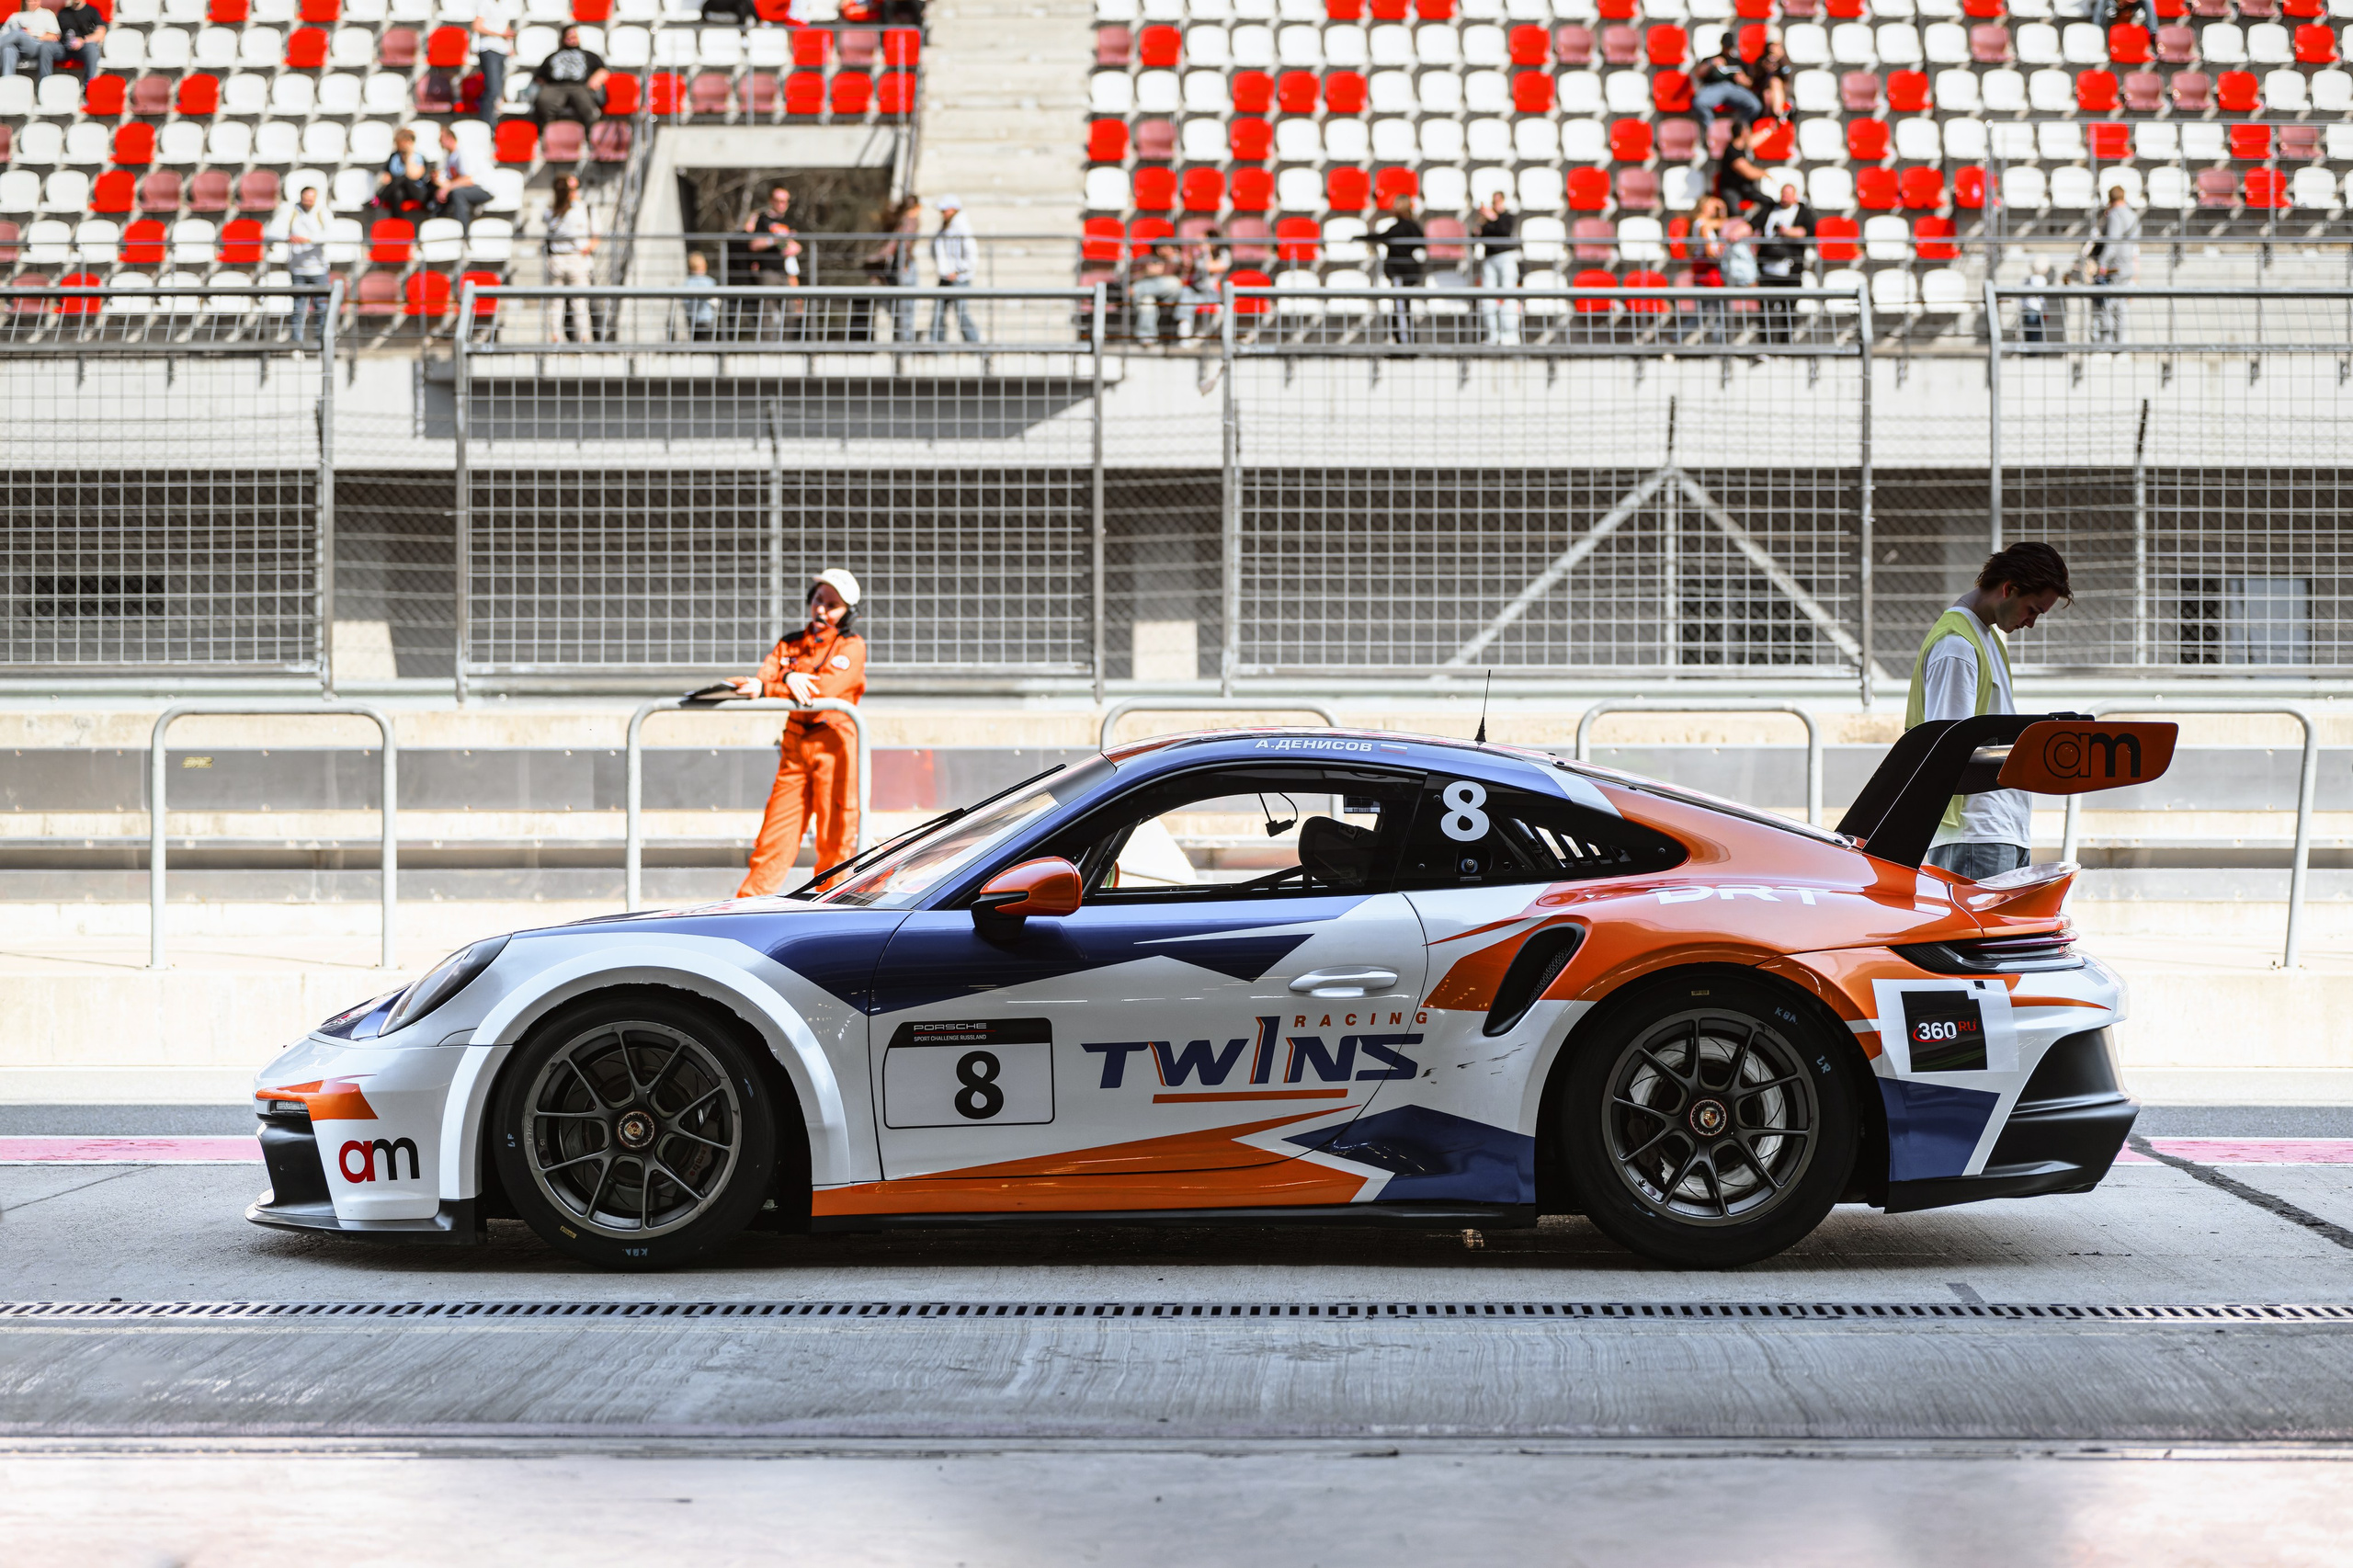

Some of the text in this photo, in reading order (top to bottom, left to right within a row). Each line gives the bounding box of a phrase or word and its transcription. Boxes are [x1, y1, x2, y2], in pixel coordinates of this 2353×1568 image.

[2043, 731, 2141, 778] am
[1440, 780, 1490, 841] 8
[1646, 884, 1832, 905] DRT
[914, 1022, 987, 1031] PORSCHE
[1294, 1012, 1427, 1028] RACING
[1081, 1016, 1424, 1089] TWINS
[1816, 1055, 1832, 1074] LR
[954, 1051, 1005, 1119] 8
[338, 1137, 421, 1184] am
